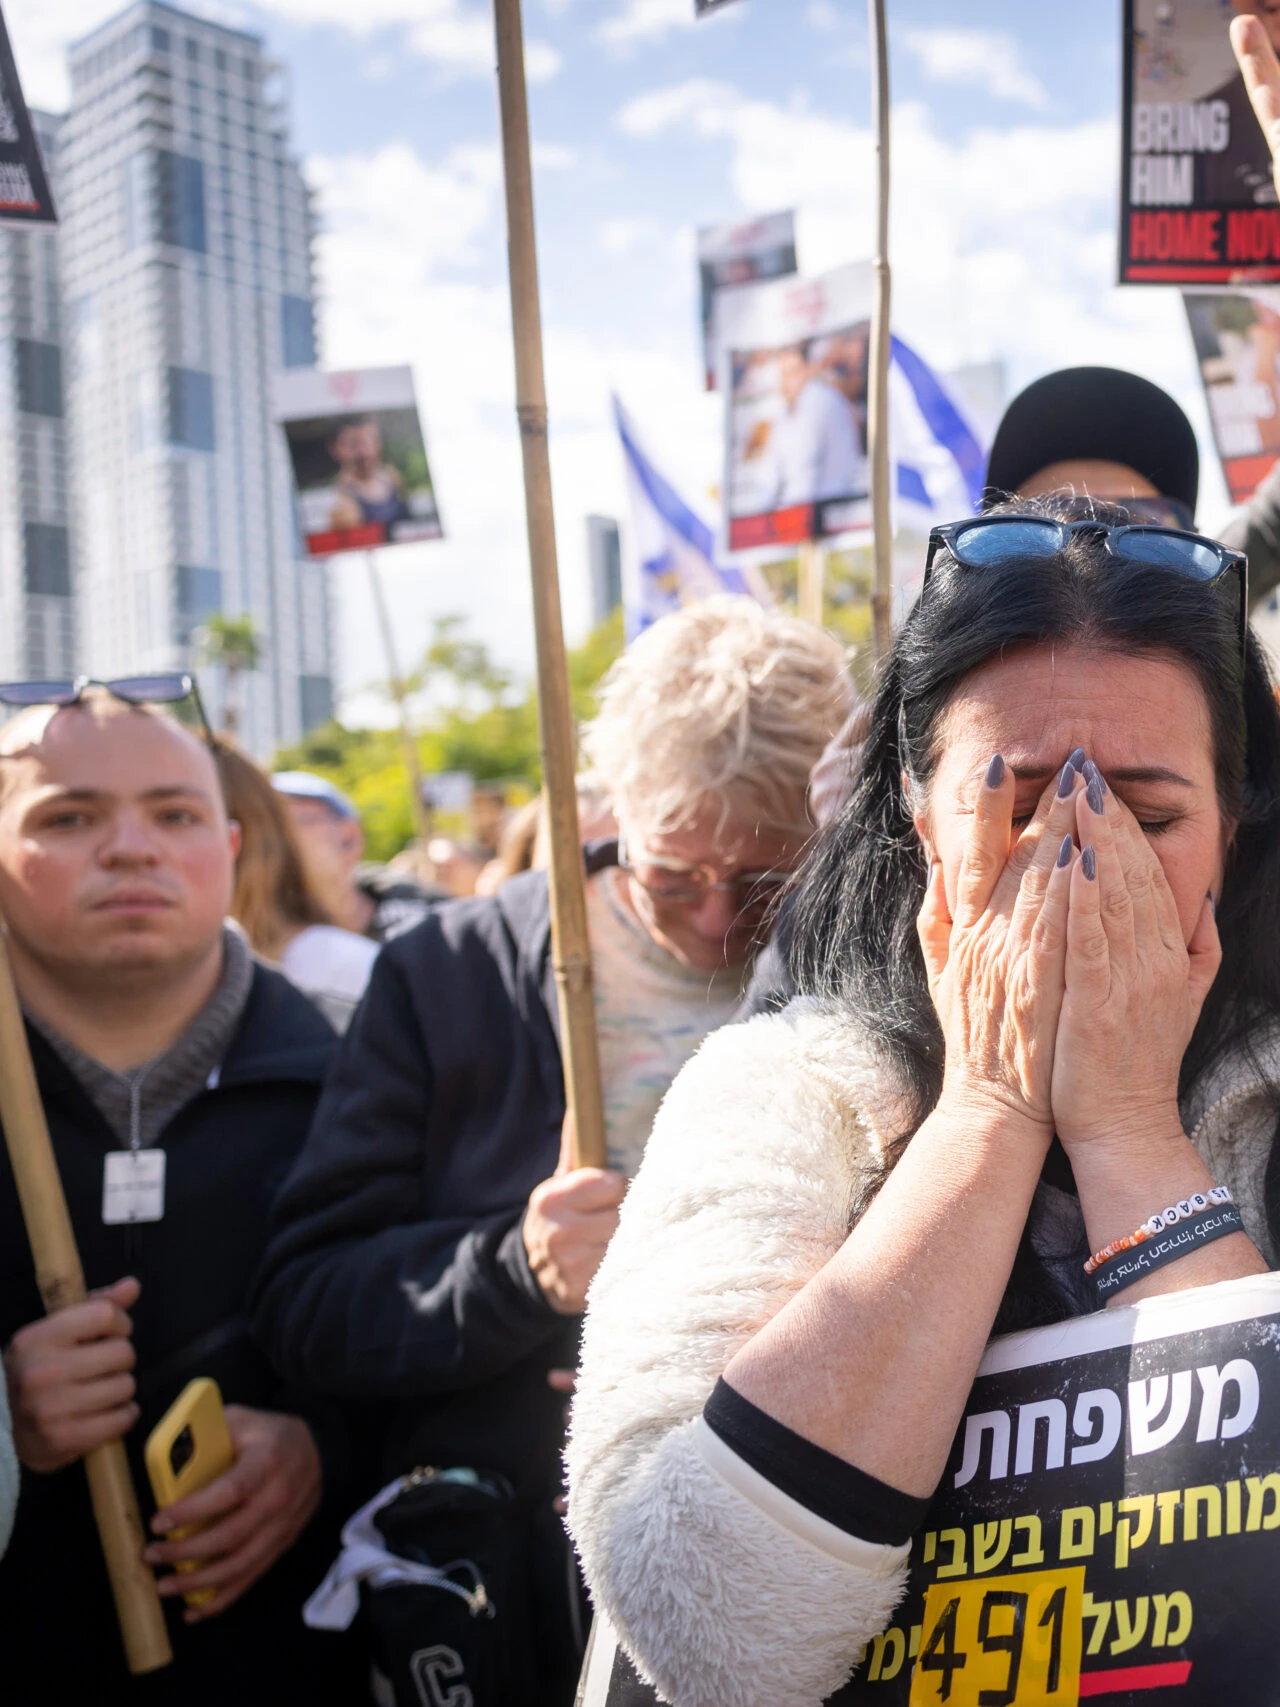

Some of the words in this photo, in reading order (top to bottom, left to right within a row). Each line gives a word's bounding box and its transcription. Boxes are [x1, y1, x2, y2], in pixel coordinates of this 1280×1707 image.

[1132, 99, 1230, 154] BRING
[1130, 154, 1194, 206] HIM
[1130, 209, 1221, 262] HOME
[1153, 1195, 1205, 1229] BACK
[954, 1357, 1261, 1490] משפחת
[923, 1514, 1045, 1579] בשבי
[919, 1585, 1068, 1707] 491
[1081, 1590, 1193, 1657] מעל
